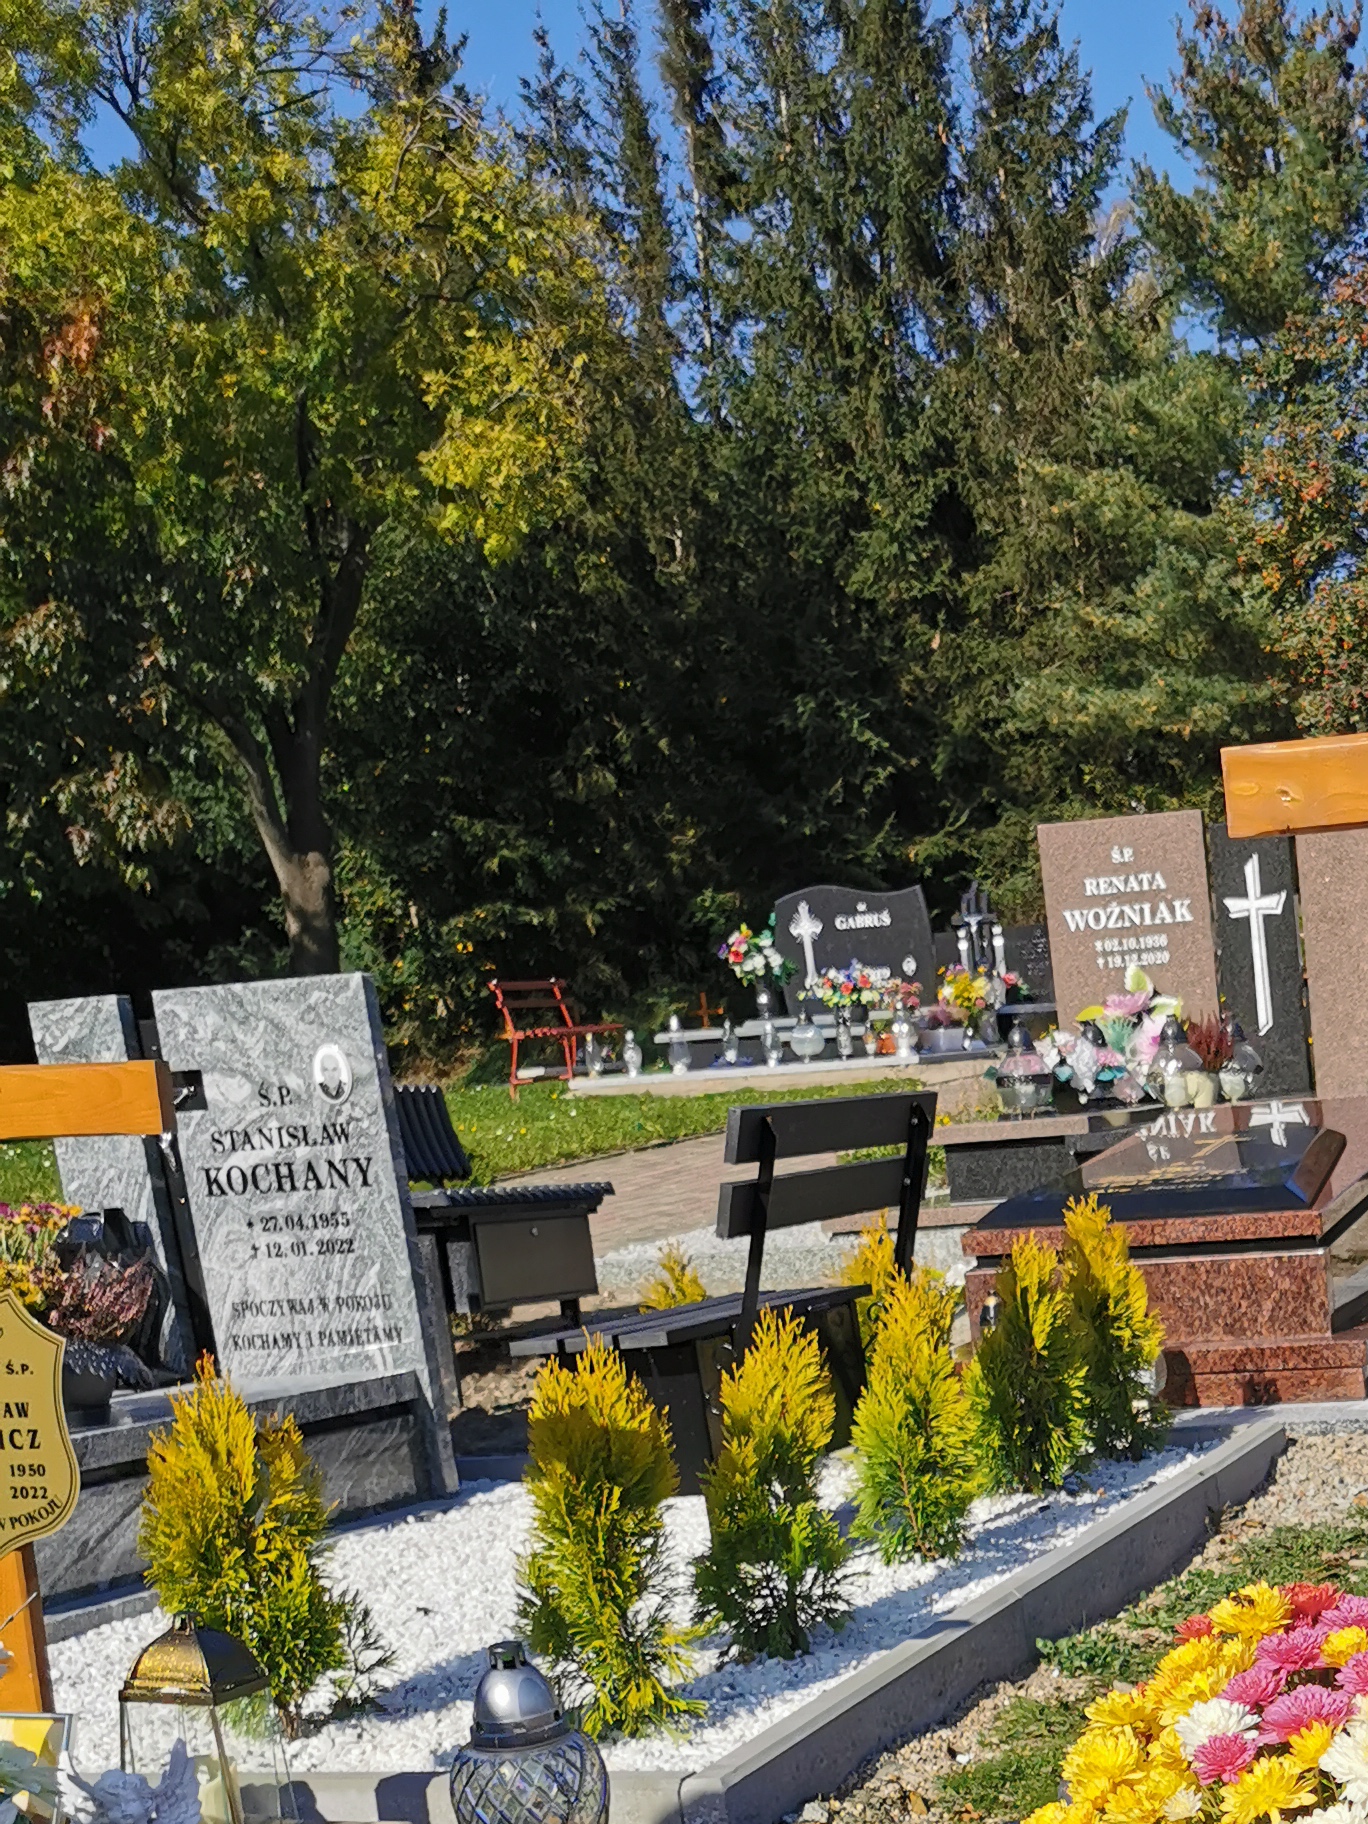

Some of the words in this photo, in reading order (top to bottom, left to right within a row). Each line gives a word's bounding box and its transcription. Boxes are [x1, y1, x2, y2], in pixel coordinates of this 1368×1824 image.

[1084, 871, 1167, 896] RENATA
[1063, 897, 1194, 932] WOŹNIAK
[203, 1157, 373, 1198] KOCHANY
[231, 1298, 315, 1320] SPOCZYWAJ
[336, 1294, 394, 1314] POKOJU
[231, 1331, 302, 1351] KOCHAMY
[10, 1464, 47, 1478] 1950
[10, 1486, 48, 1500] 2022
[10, 1494, 64, 1531] POKOJU
